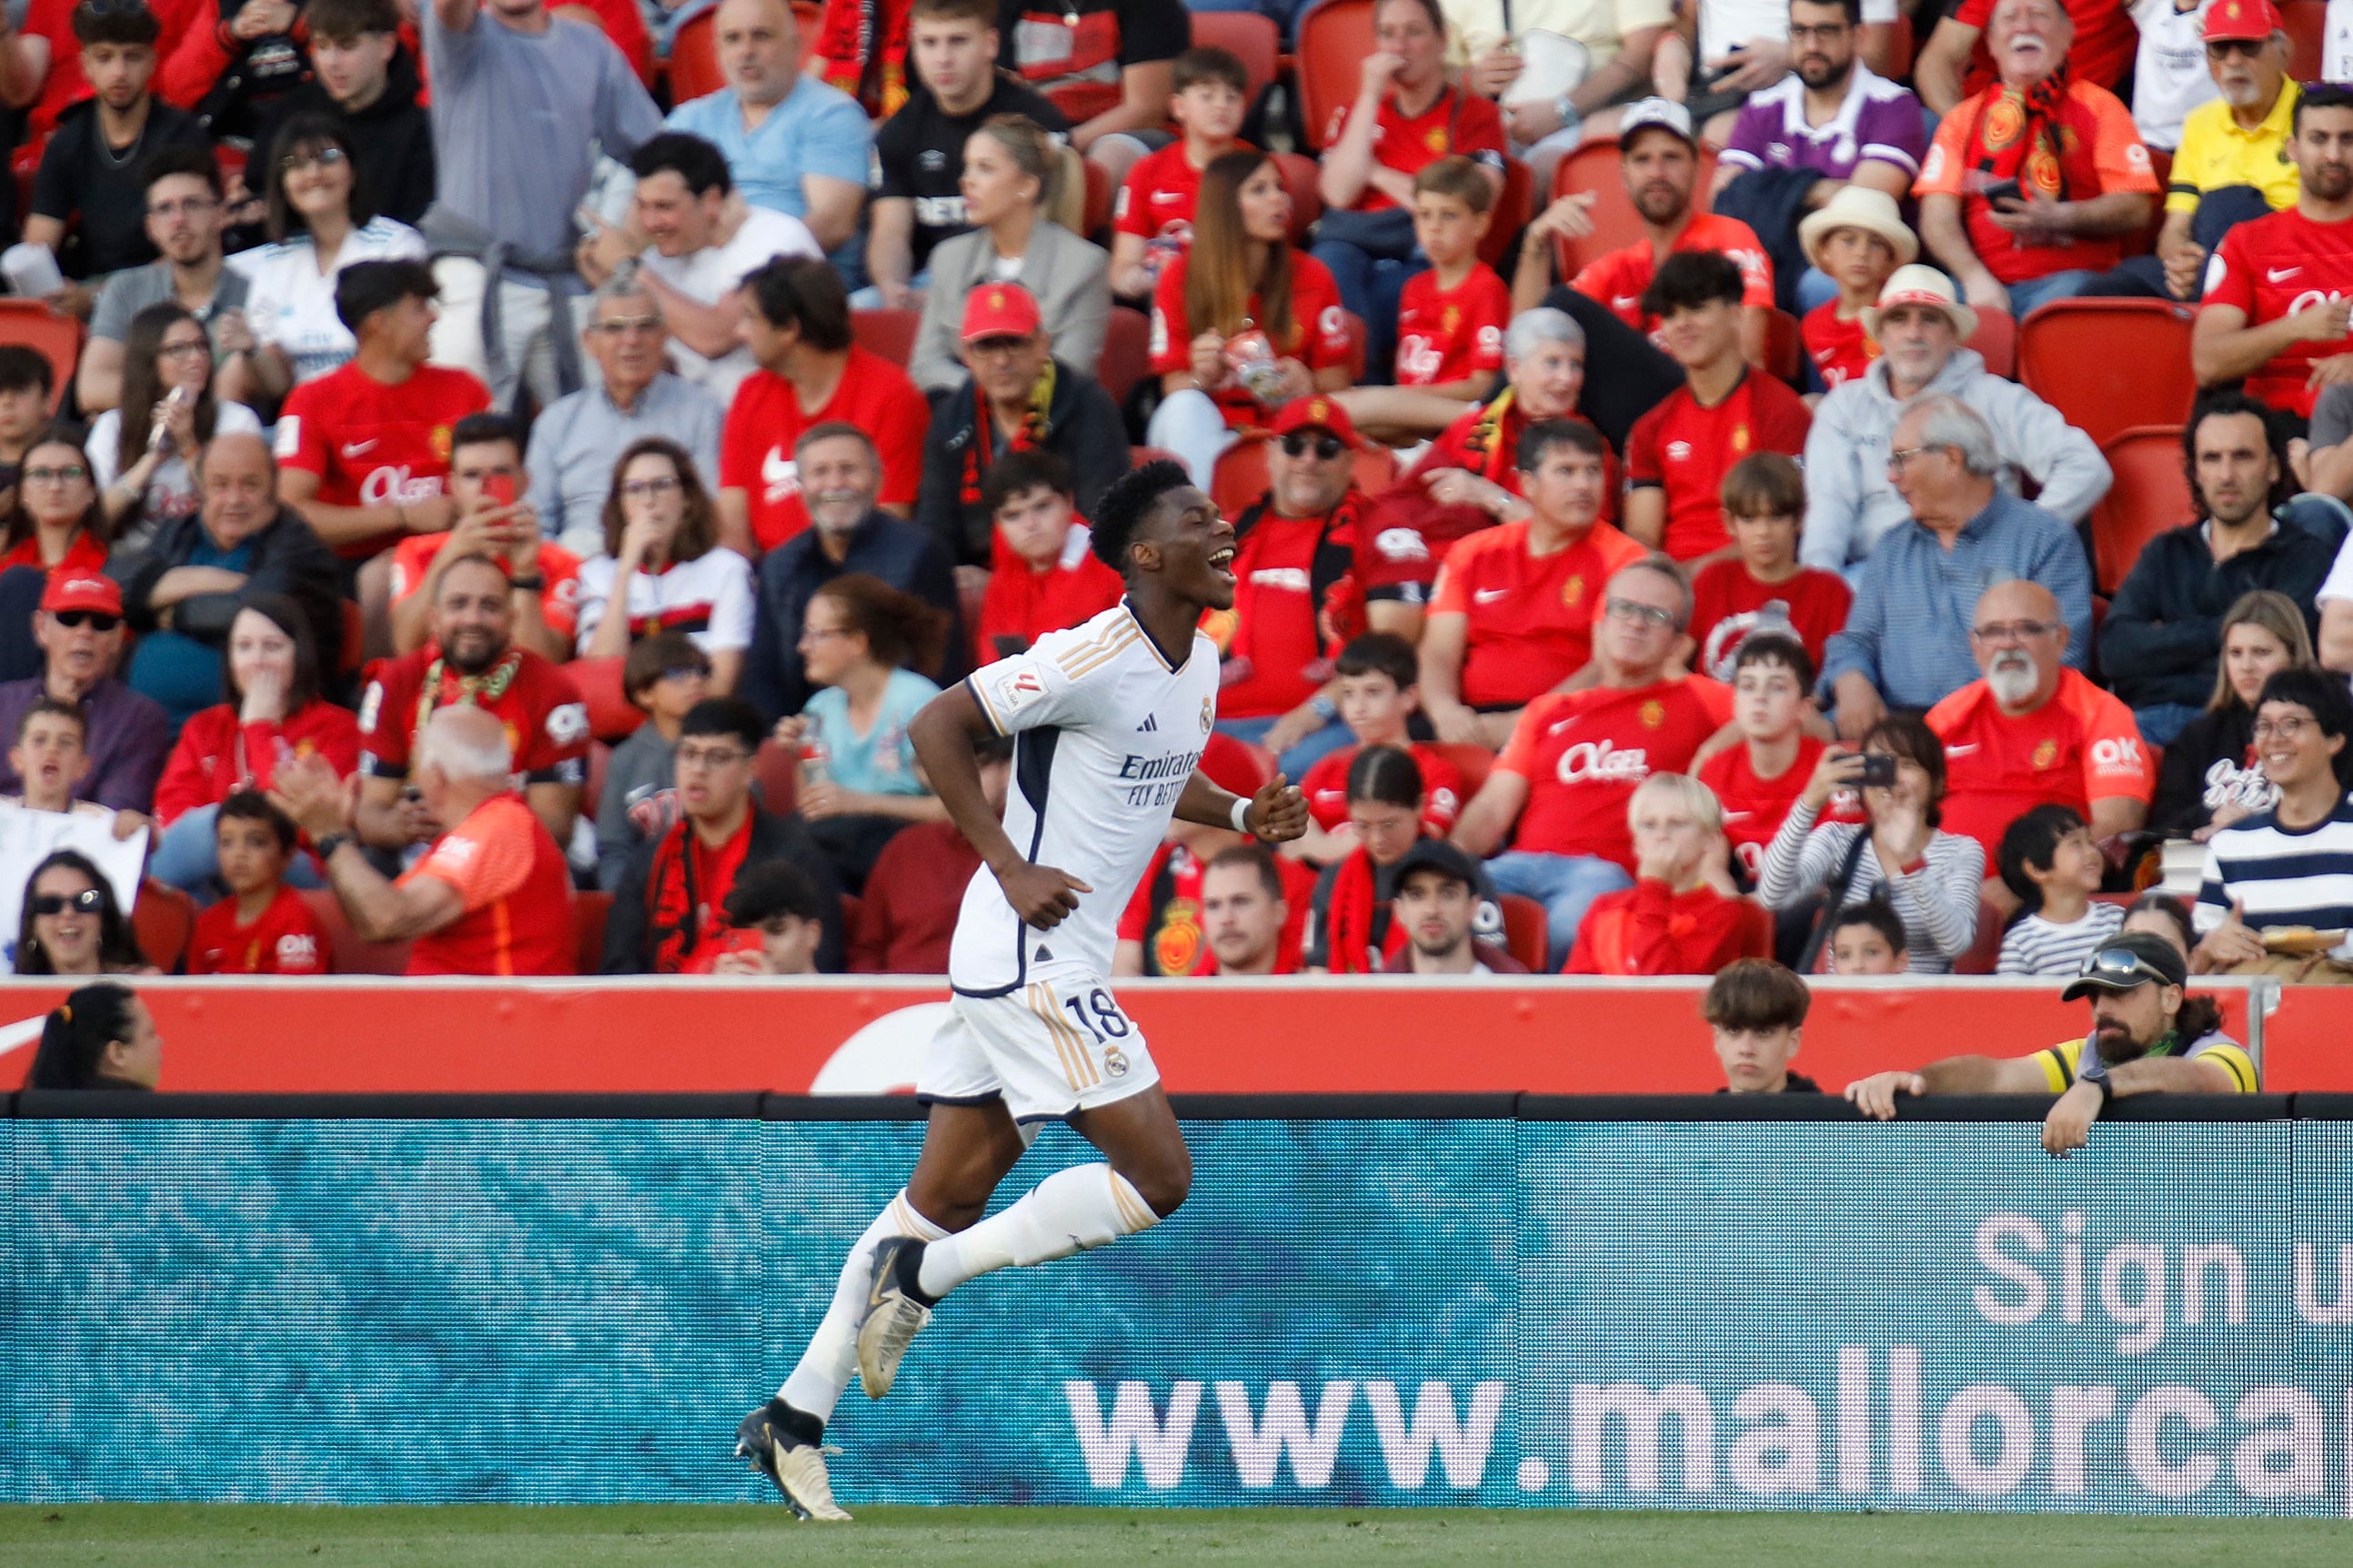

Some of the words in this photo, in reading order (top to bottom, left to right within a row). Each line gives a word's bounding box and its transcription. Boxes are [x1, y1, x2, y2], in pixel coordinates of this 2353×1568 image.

[2092, 736, 2143, 763] OK
[1128, 783, 1154, 806] FLY
[1065, 988, 1130, 1044] 18
[1972, 1209, 2248, 1355] Sign
[1064, 1343, 2353, 1499] www.mallorca
